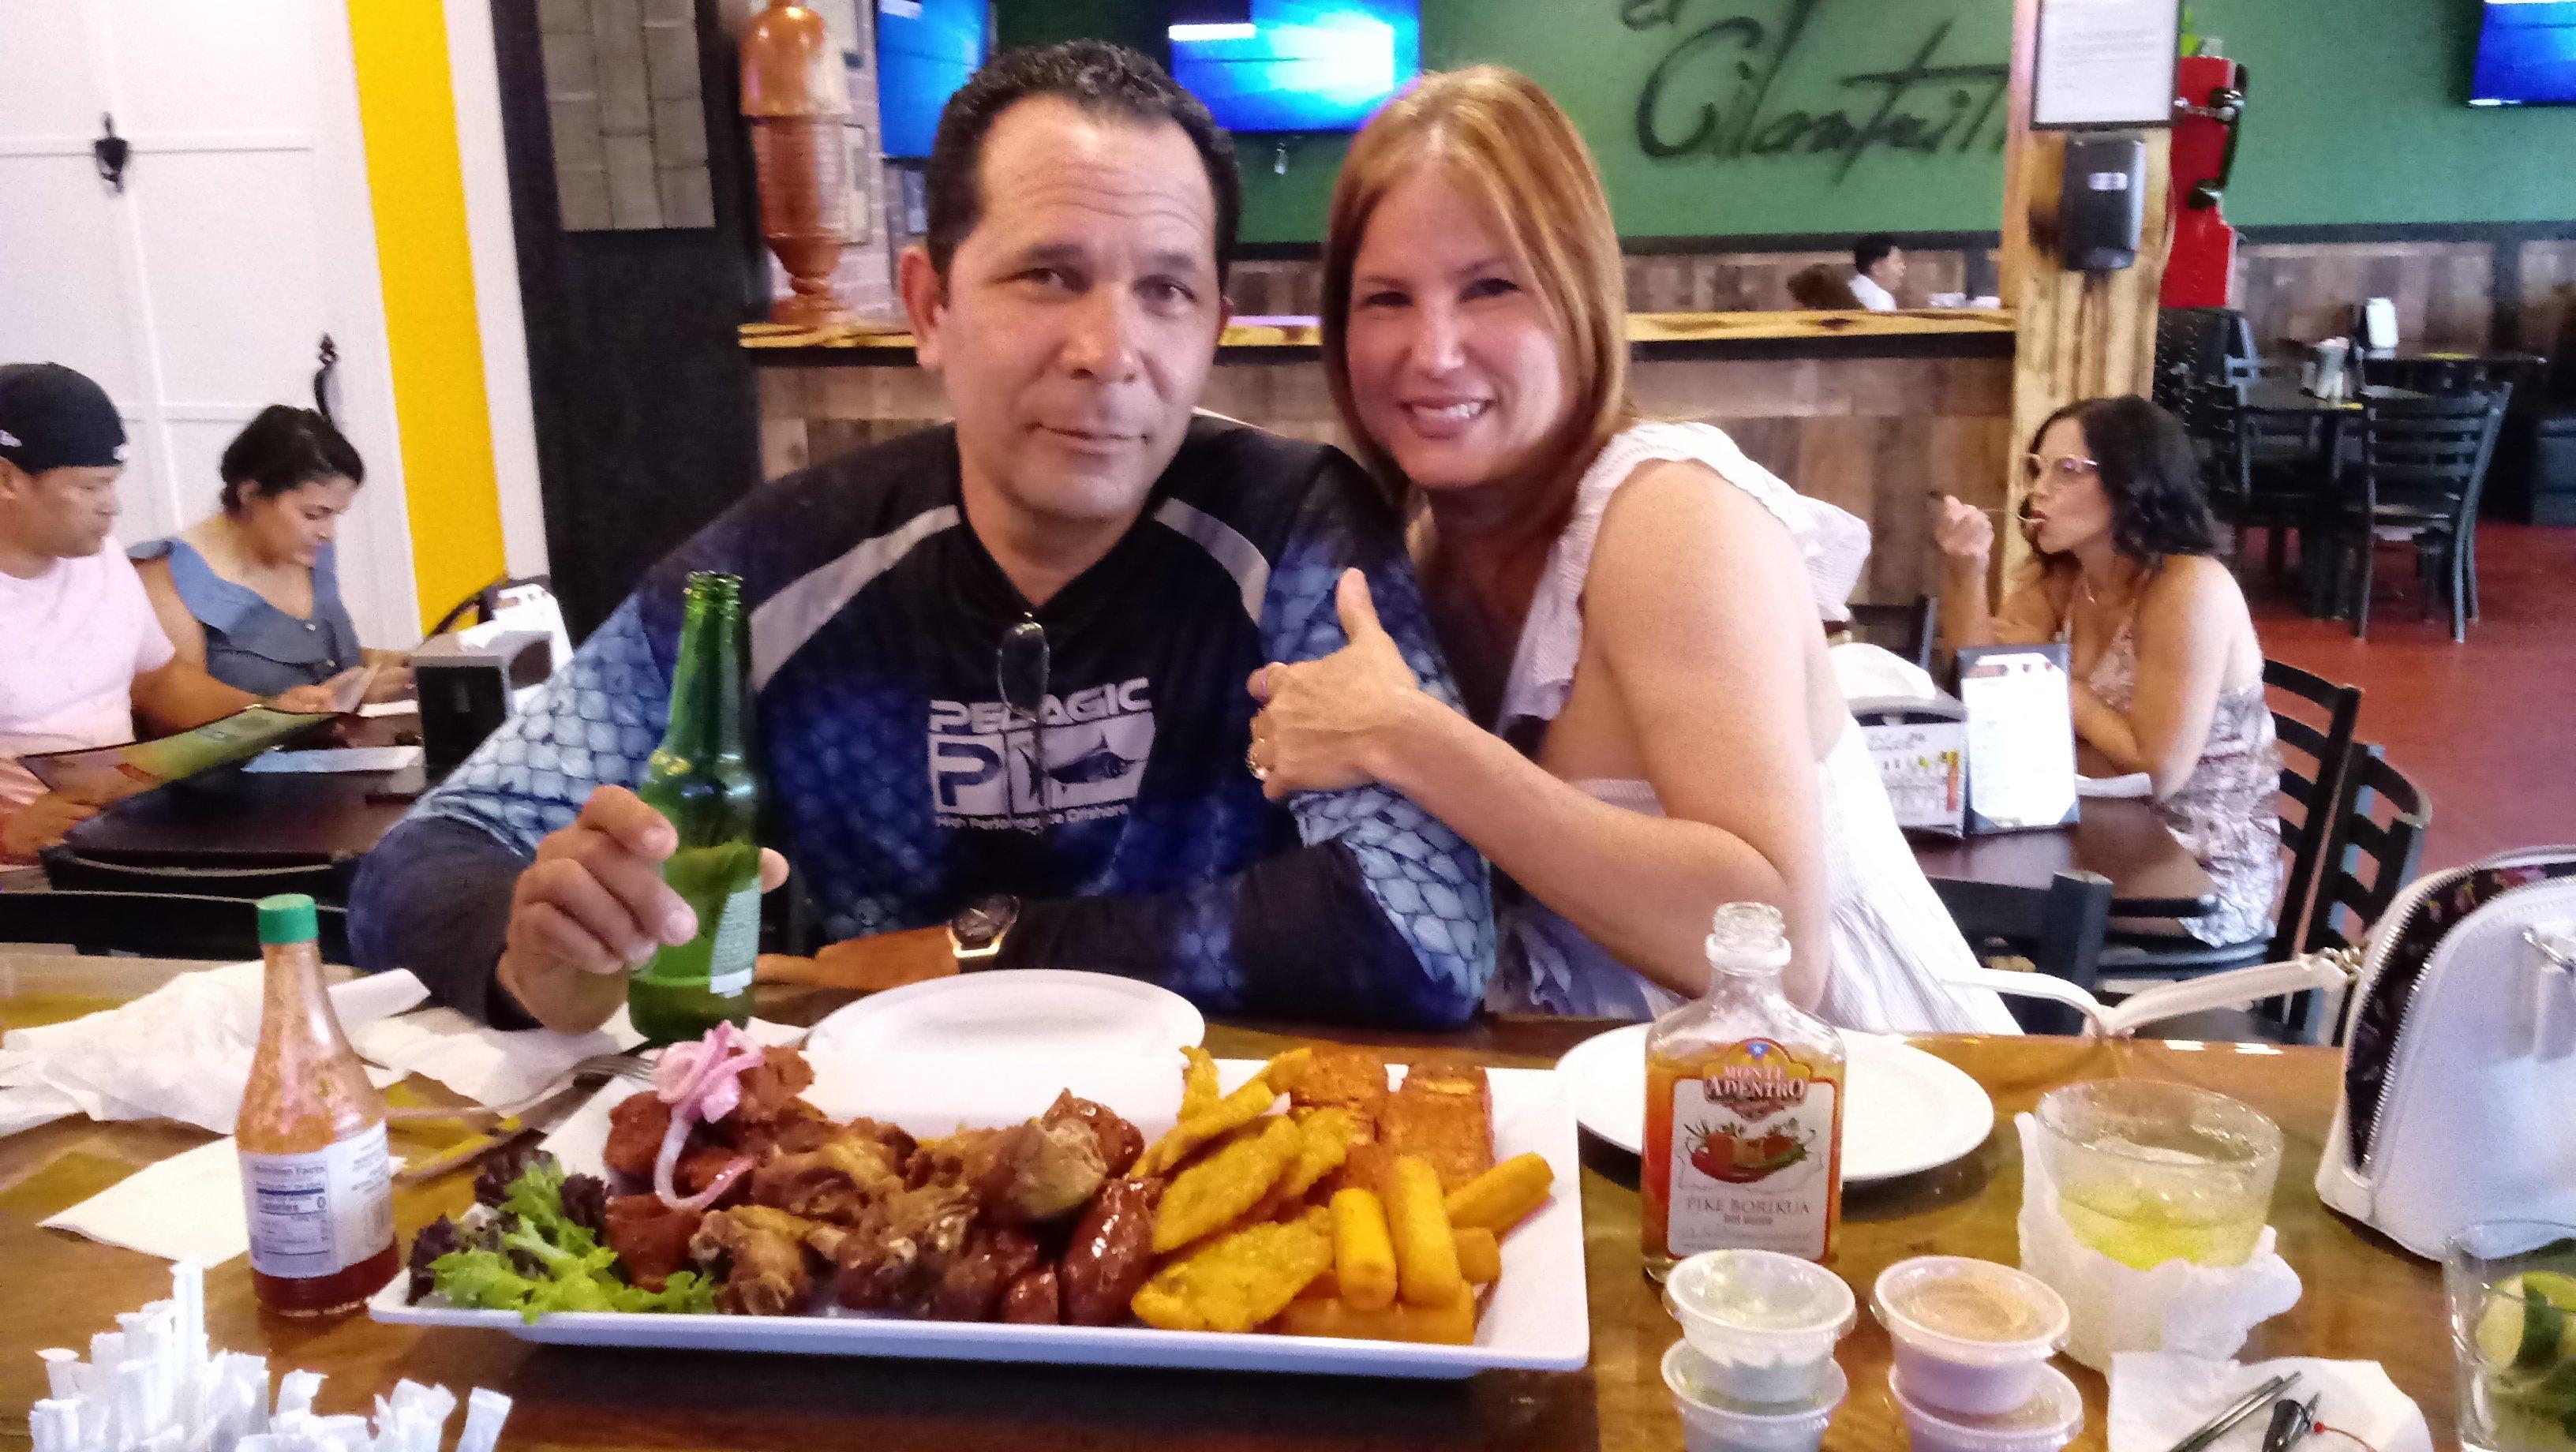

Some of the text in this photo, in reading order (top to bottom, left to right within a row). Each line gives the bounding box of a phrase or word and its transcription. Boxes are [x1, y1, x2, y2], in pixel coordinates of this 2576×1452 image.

[929, 676, 1153, 733] PELAGIC
[1724, 1065, 1786, 1081] MONTE
[1704, 1075, 1806, 1098] ADENTRO
[1686, 1196, 1810, 1214] PIKE BORIKUA
